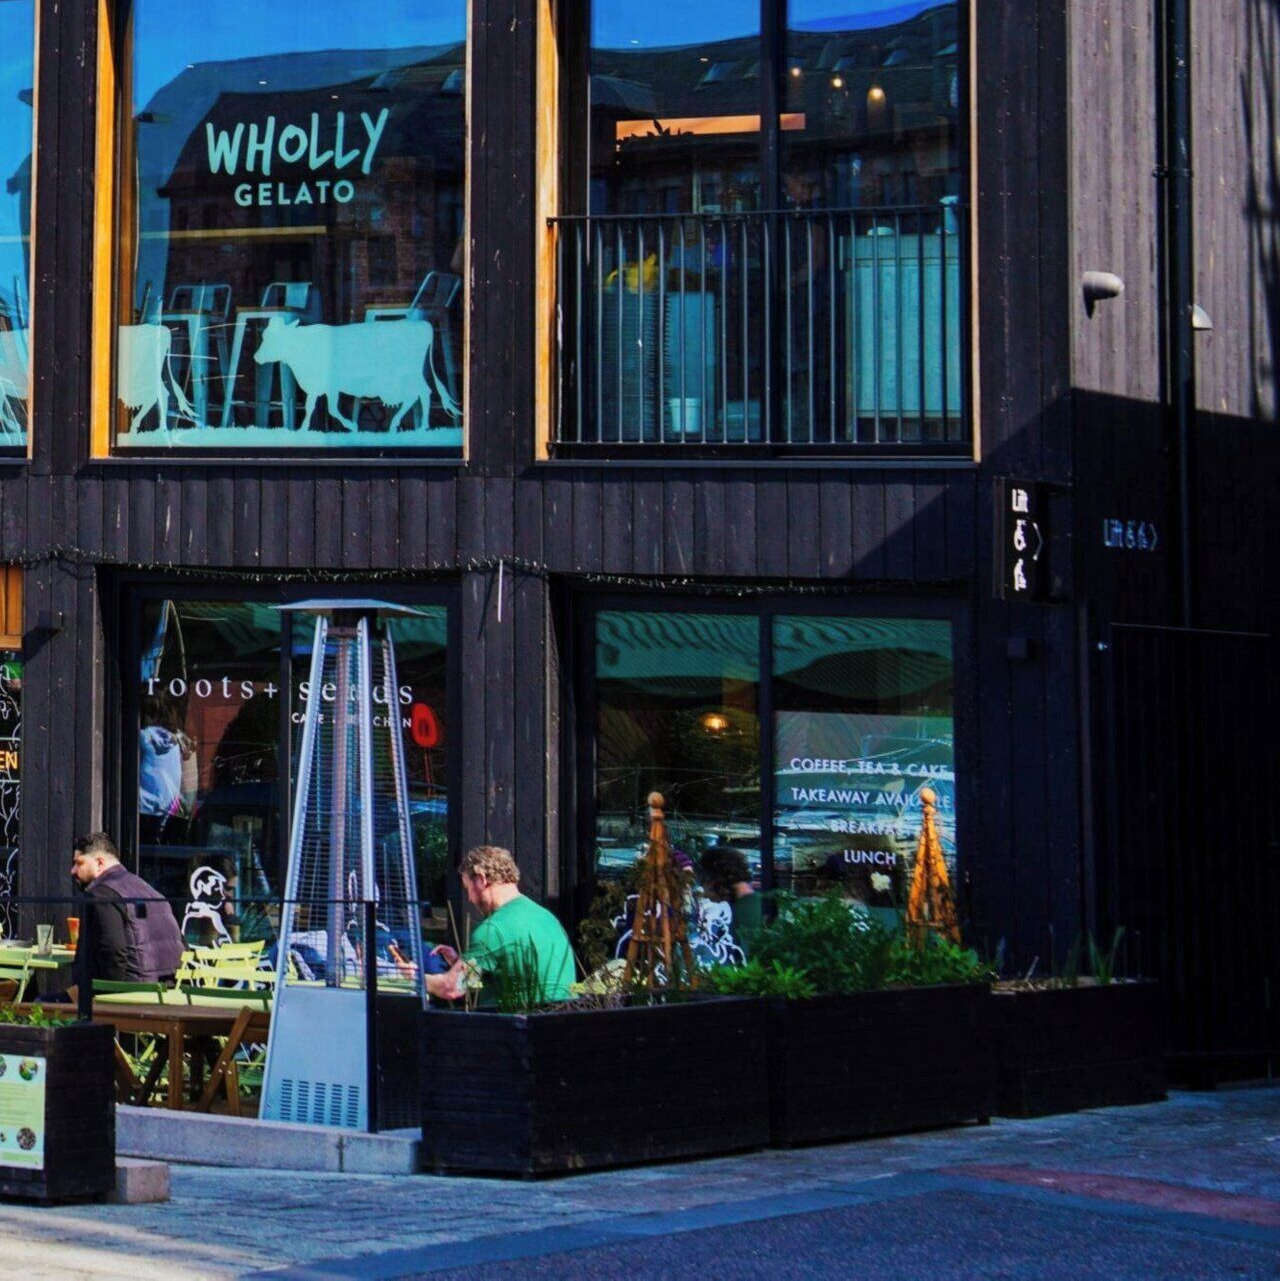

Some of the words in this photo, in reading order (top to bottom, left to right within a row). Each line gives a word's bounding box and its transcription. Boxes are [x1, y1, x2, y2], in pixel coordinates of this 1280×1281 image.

[206, 107, 389, 177] WHOLLY
[234, 178, 355, 208] GELATO
[292, 712, 324, 724] CAE
[790, 758, 852, 775] COFFEE,
[858, 761, 886, 774] TEA
[893, 763, 901, 775] &
[907, 764, 948, 777] CAKE
[791, 787, 870, 804] TAKEAWAY
[844, 849, 896, 865] LUNCH
